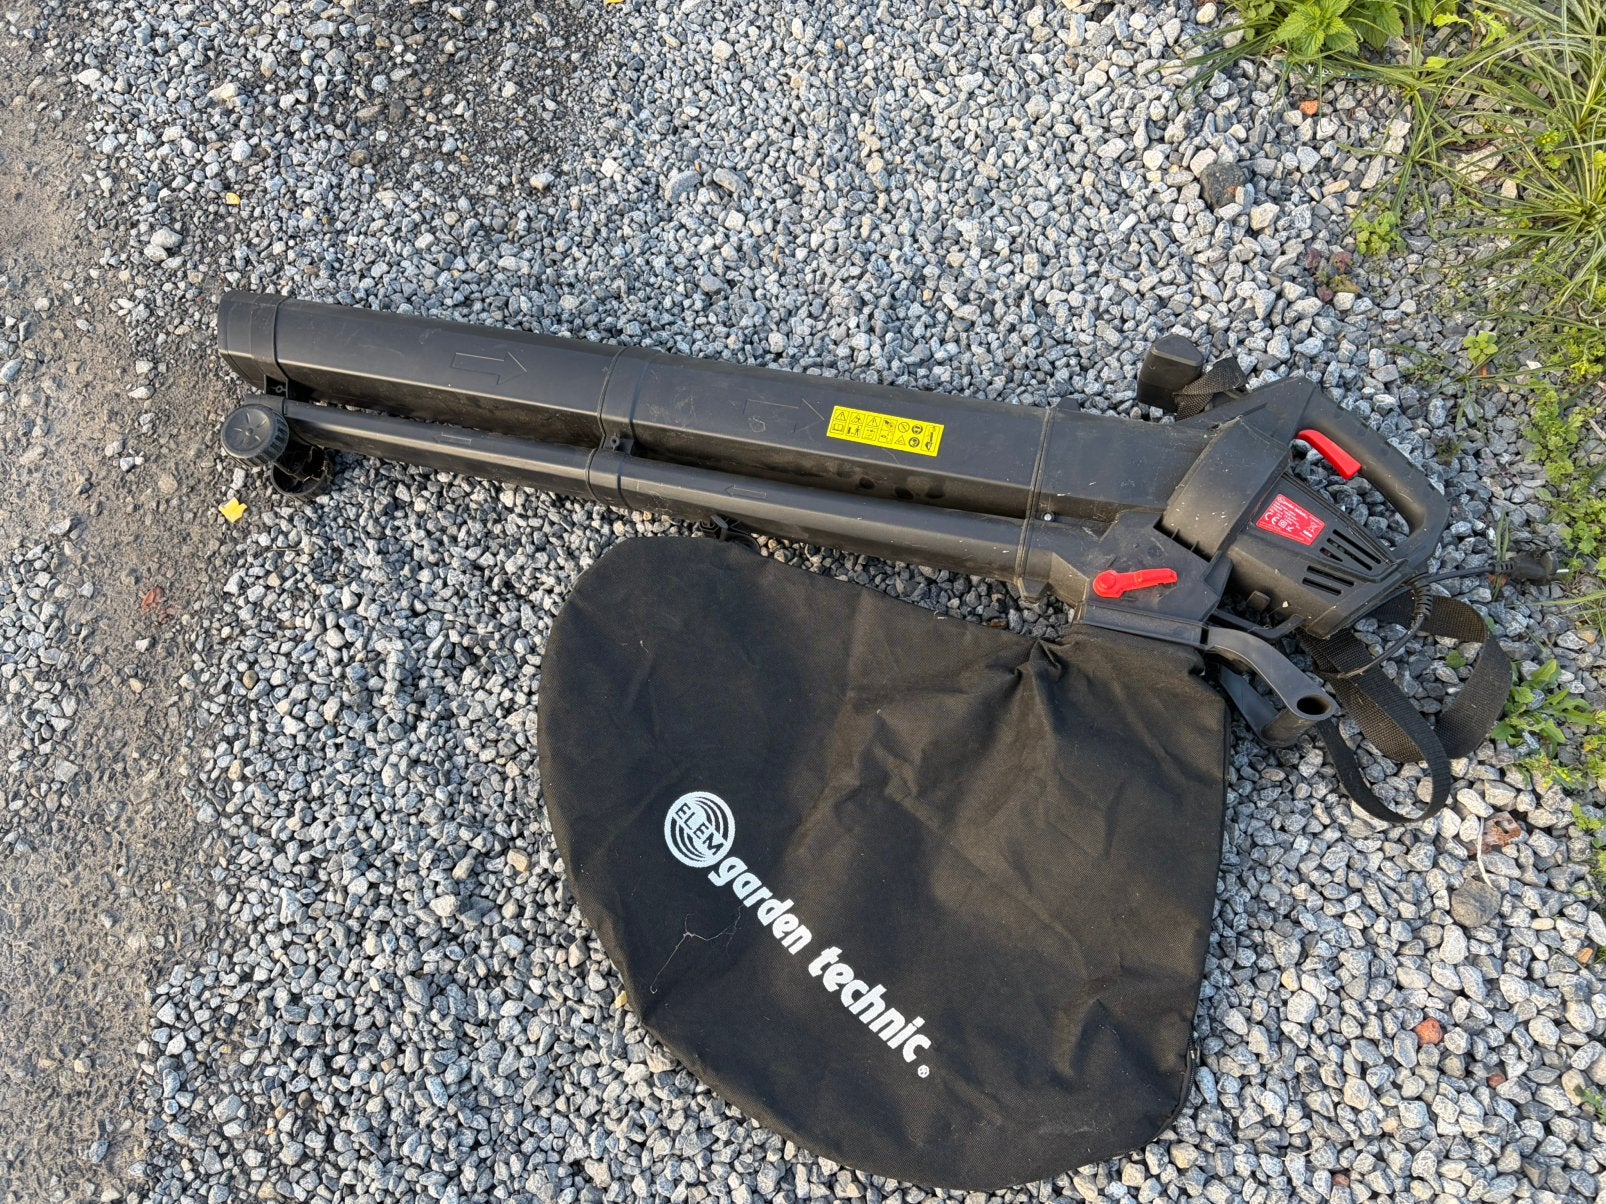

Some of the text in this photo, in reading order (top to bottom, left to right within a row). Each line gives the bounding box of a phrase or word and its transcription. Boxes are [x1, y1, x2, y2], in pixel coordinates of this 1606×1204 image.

[675, 802, 724, 856] ELEM
[707, 856, 932, 1063] garden technic
